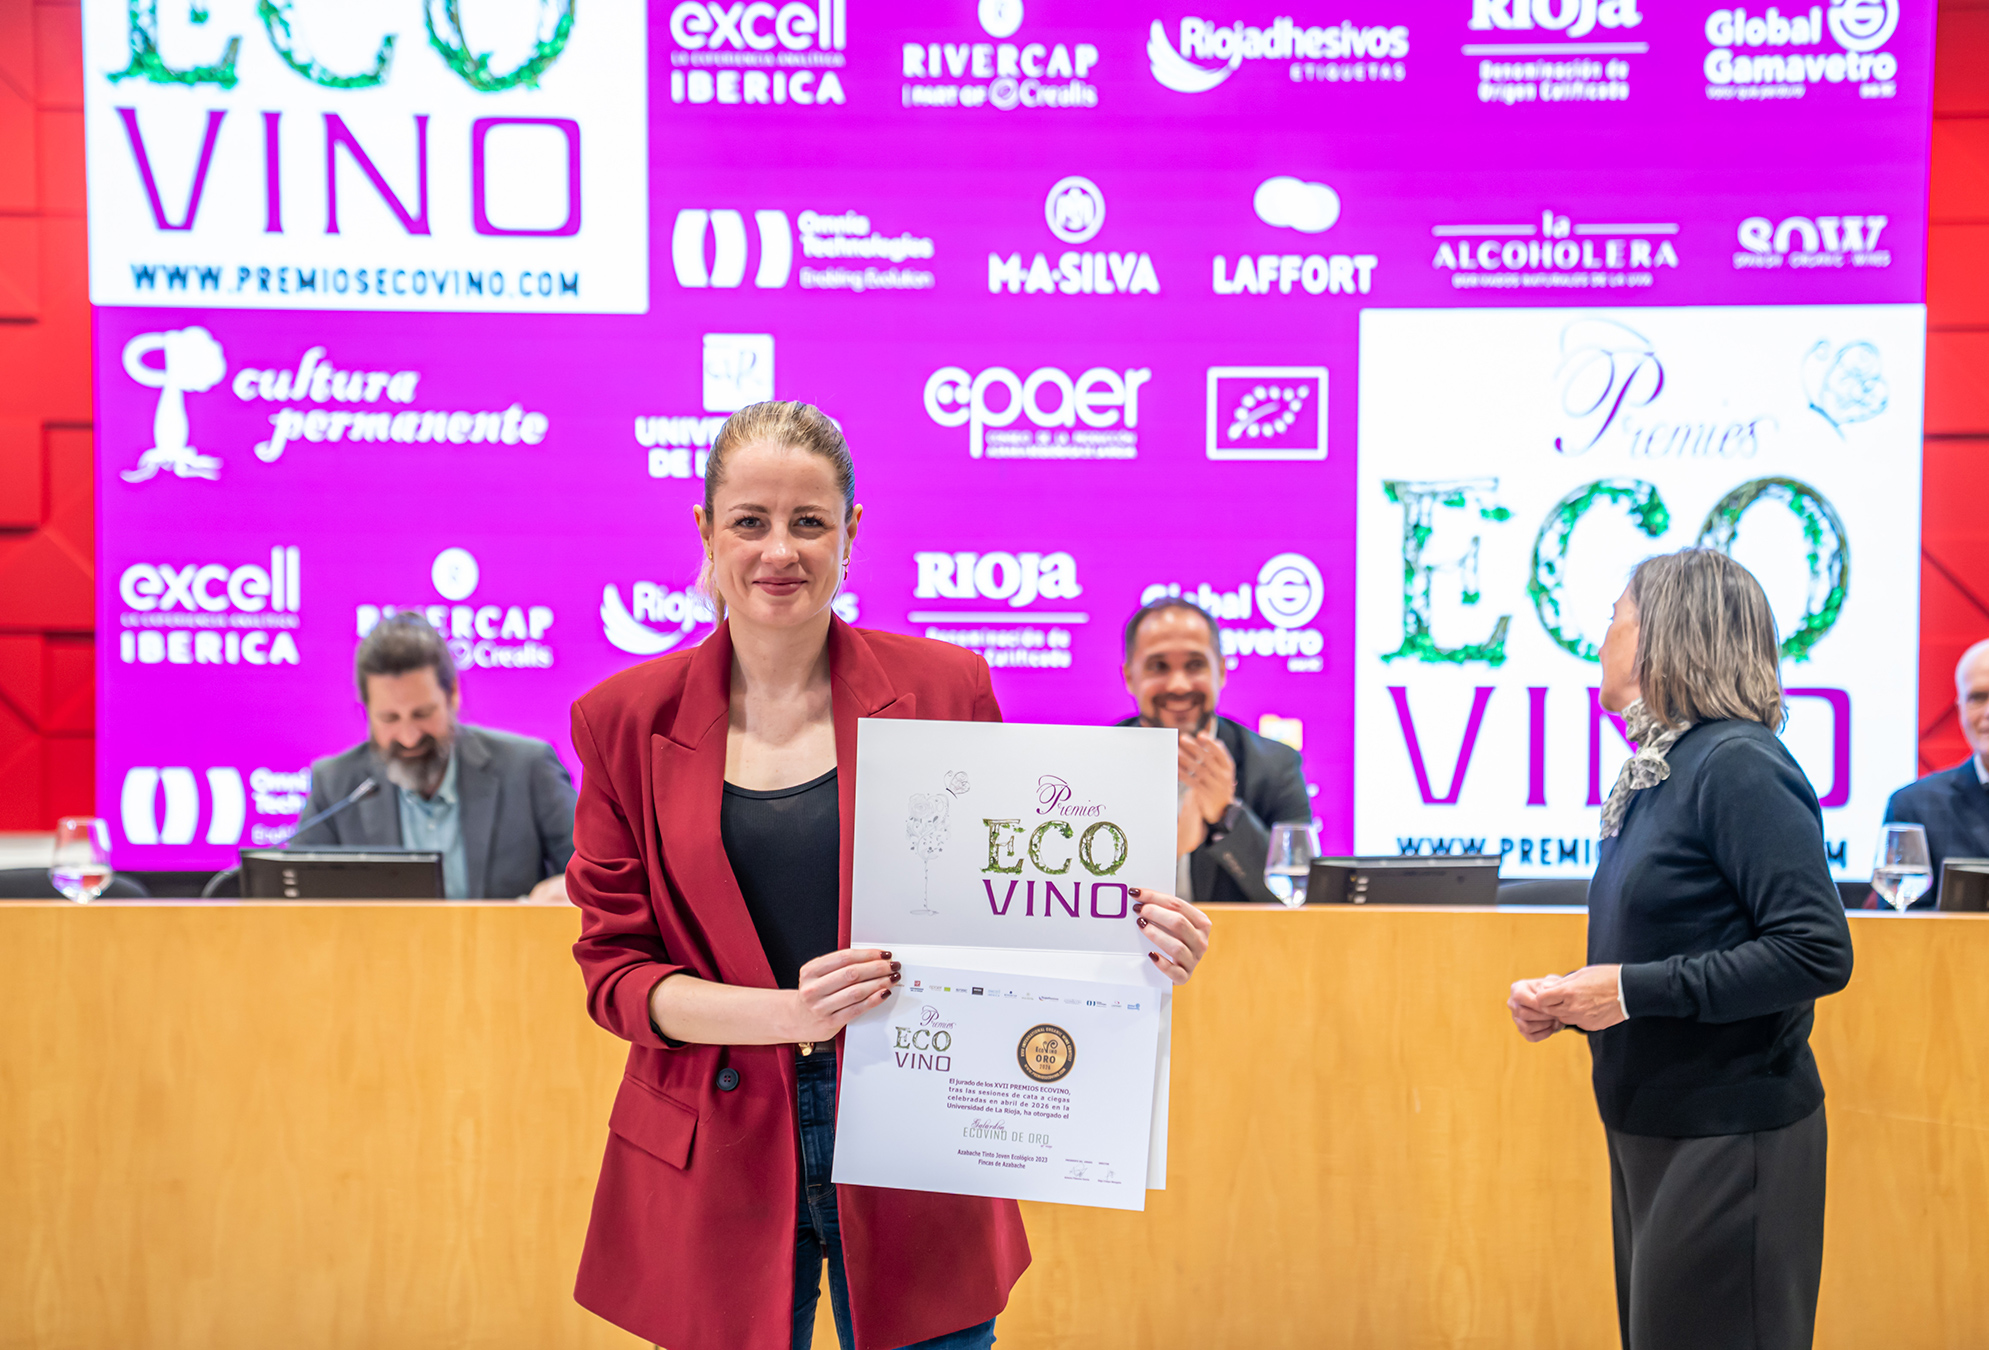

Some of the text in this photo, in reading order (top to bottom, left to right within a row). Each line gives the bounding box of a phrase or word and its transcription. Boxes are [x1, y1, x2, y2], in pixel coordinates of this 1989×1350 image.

[669, 0, 847, 51] excell
[1180, 15, 1409, 71] Riojadhesivos
[1705, 5, 1823, 47] Global
[902, 42, 1099, 78] RIVERCAP
[1703, 47, 1898, 84] Gamavetro
[670, 69, 847, 104] IBERICA
[114, 106, 582, 237] VINO
[1542, 209, 1571, 239] la
[1431, 238, 1680, 270] ALCOHOLERA
[129, 262, 580, 298] WWW.PREMIOSECOVINO.COM
[1212, 254, 1378, 295] LAFFORT
[232, 345, 422, 404] cultura
[253, 401, 549, 463] permanente
[648, 448, 693, 478] DE
[119, 545, 300, 612] excell
[120, 630, 300, 665] IBERICA
[979, 818, 1128, 876] ECO
[982, 879, 1128, 919] VINO
[893, 1026, 952, 1052] ECO
[895, 1052, 951, 1072] VINO
[1036, 1054, 1056, 1064] ORO
[948, 1095, 987, 1103] celebradas
[1010, 1084, 1039, 1092] PREMIOS
[1040, 1087, 1071, 1096] ECOVINO,
[947, 1103, 984, 1111] Universidad
[1004, 1108, 1022, 1116] Rioja,
[1033, 1111, 1061, 1119] otorgado
[963, 1126, 1050, 1145] ECOVINO DE ORO
[957, 1149, 981, 1157] Azabache
[1011, 1153, 1034, 1162] Ecológico
[978, 1159, 994, 1167] Fincas
[1002, 1161, 1026, 1169] Azabache
